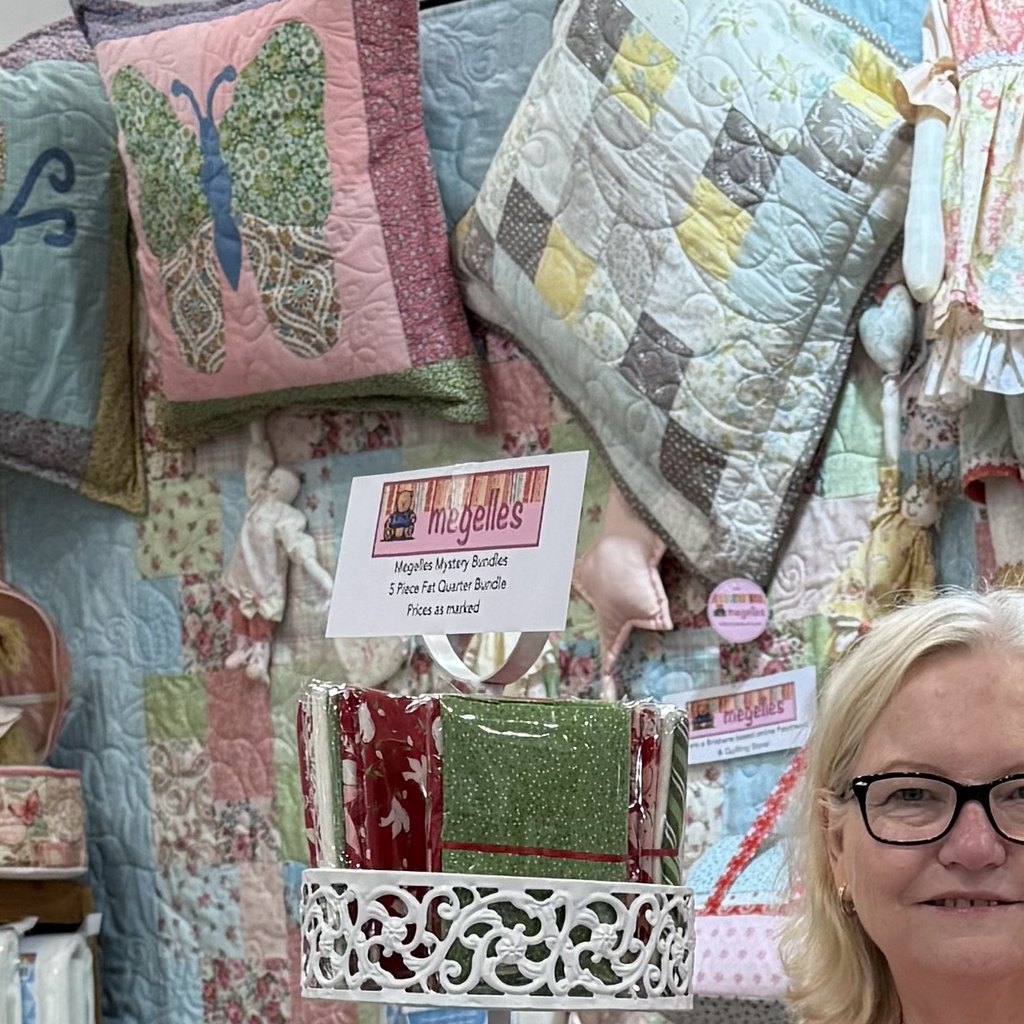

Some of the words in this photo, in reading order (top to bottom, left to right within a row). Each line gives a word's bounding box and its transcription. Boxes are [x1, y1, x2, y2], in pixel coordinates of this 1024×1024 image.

[428, 488, 524, 546] megelles
[394, 558, 433, 576] Megelles
[435, 557, 469, 574] Mystery
[471, 552, 508, 568] Bundles
[388, 582, 395, 596] 5
[396, 581, 420, 595] Piece
[421, 580, 436, 593] Fat
[438, 579, 472, 593] Quarter
[474, 576, 507, 591] Bundle
[407, 603, 432, 616] Prices
[434, 605, 444, 616] as
[446, 599, 480, 615] marked
[724, 696, 785, 726] megelles
